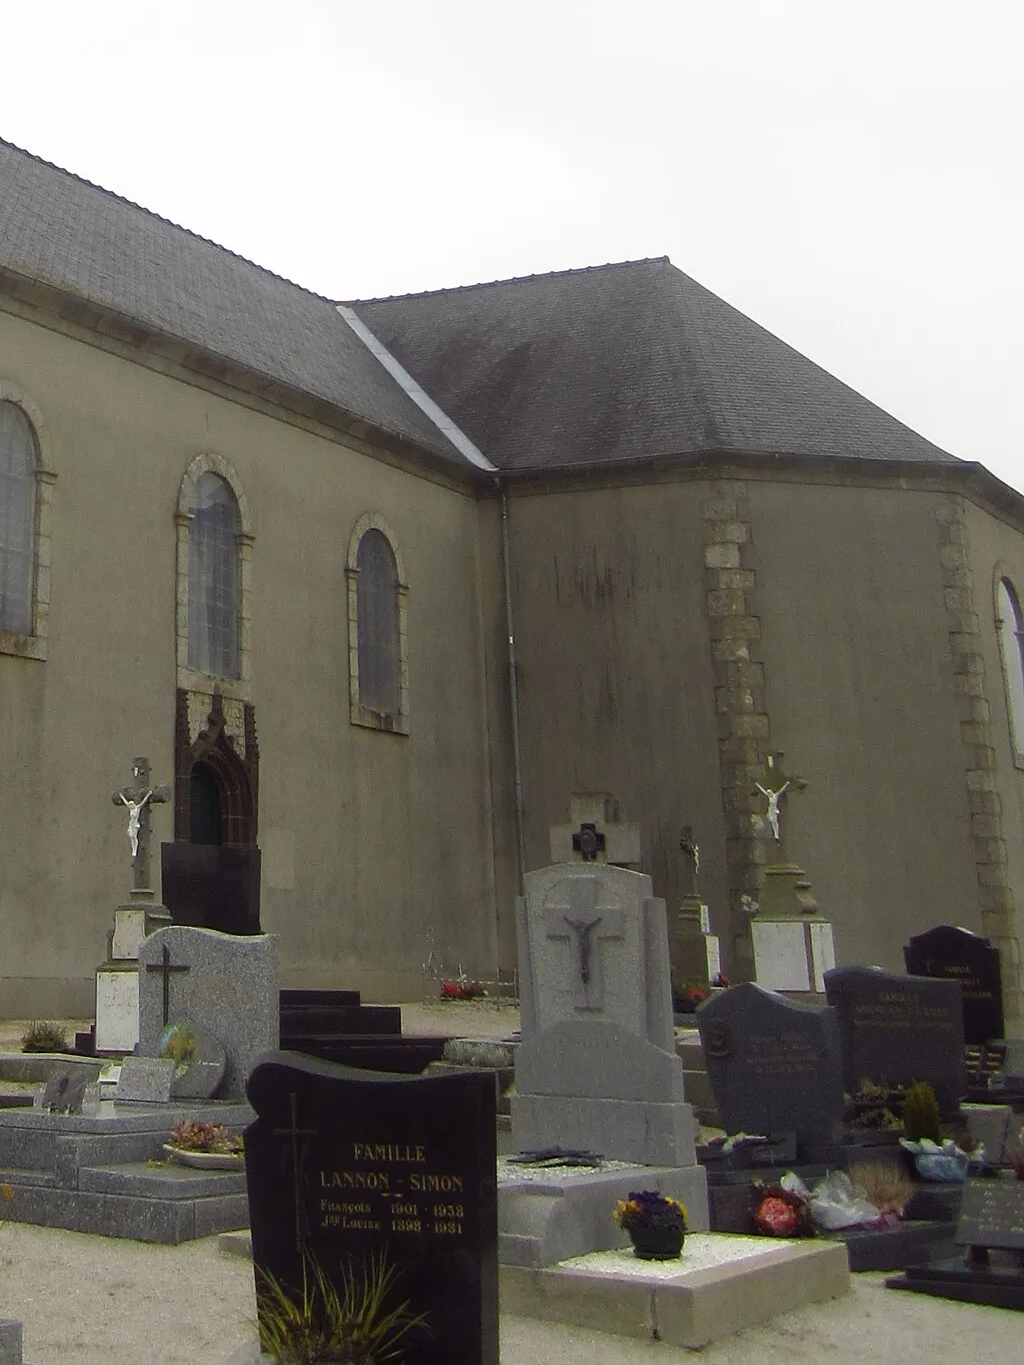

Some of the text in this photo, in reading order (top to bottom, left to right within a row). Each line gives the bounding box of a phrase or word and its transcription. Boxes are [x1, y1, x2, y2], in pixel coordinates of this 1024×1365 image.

[353, 1142, 425, 1162] FAMILLE
[320, 1170, 389, 1190] LANNON
[410, 1173, 464, 1193] SIMON
[391, 1203, 417, 1215] 1901
